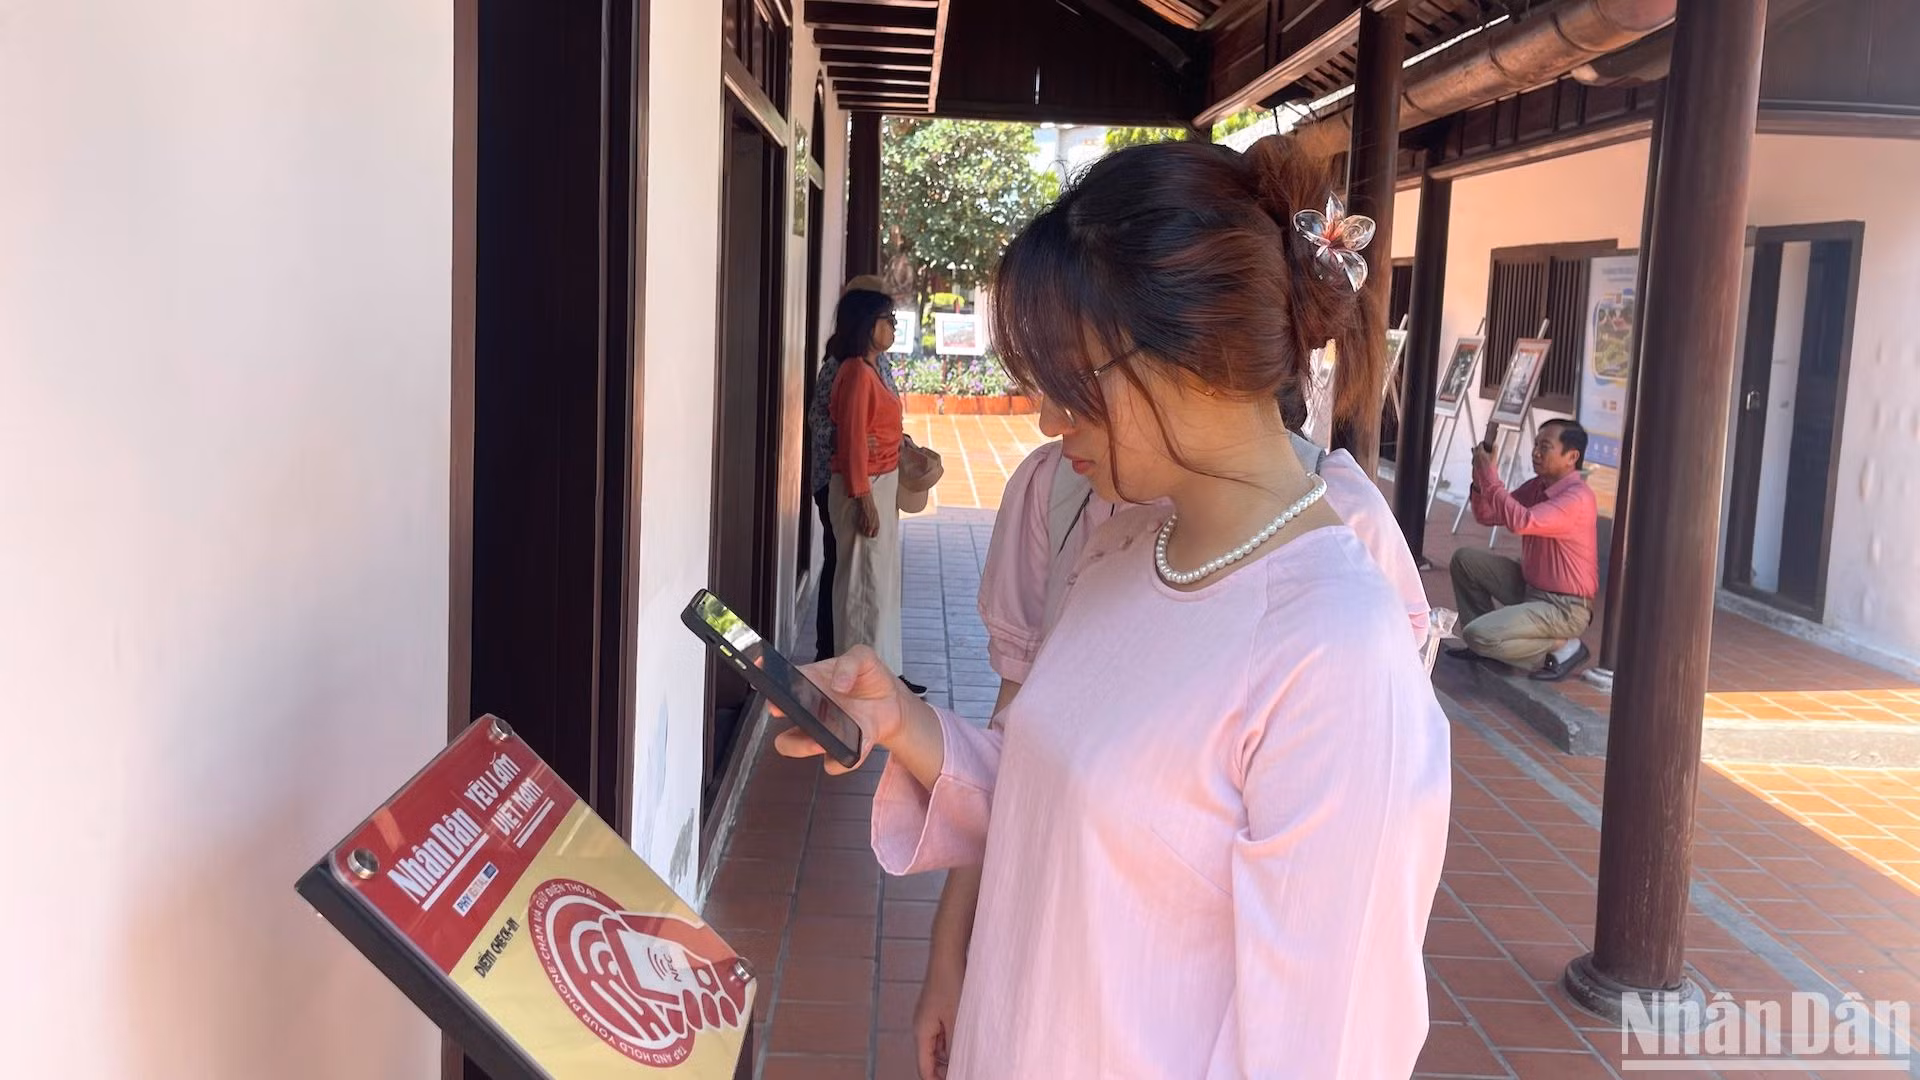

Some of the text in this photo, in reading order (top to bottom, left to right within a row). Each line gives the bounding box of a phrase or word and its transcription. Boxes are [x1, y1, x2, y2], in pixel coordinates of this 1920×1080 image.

[511, 777, 544, 813] NAM
[387, 807, 482, 904] Nhân Dân
[663, 953, 682, 982] NFC
[547, 965, 582, 1013] PHONE
[582, 1014, 616, 1045] YOUR
[619, 1041, 651, 1062] HOLD
[653, 1053, 673, 1064] AND
